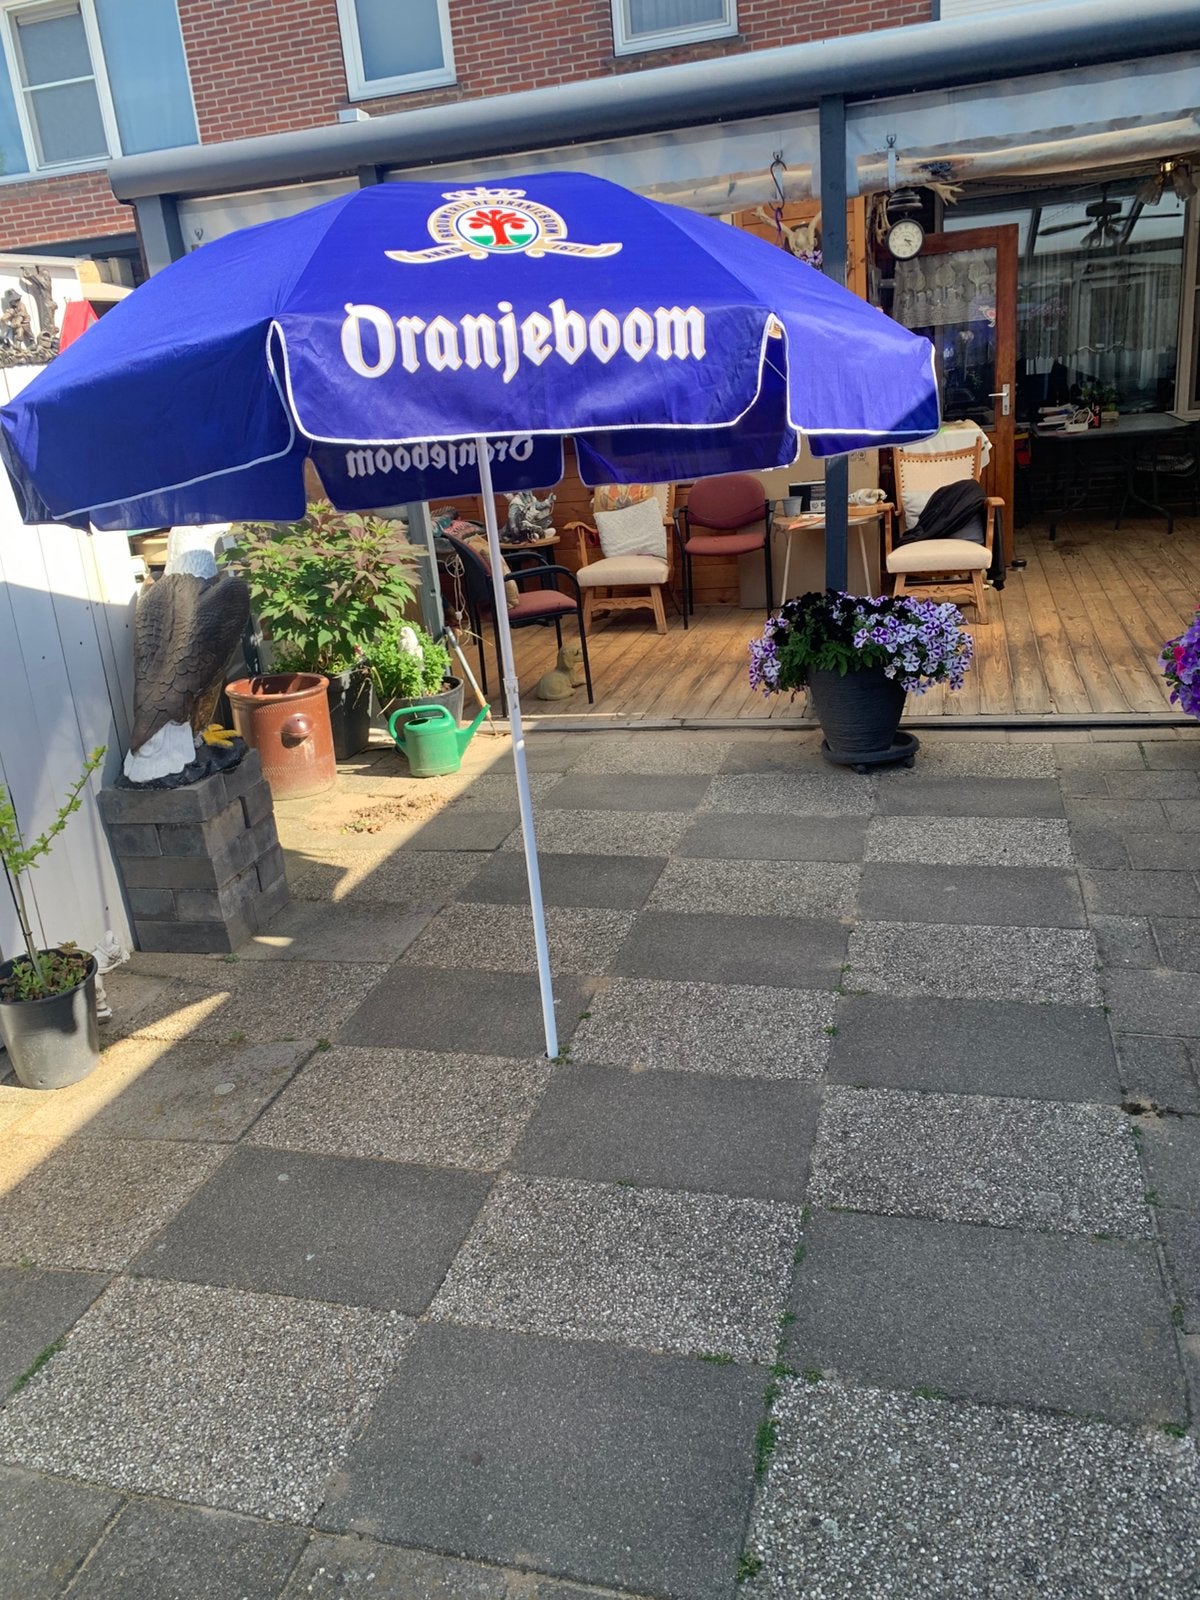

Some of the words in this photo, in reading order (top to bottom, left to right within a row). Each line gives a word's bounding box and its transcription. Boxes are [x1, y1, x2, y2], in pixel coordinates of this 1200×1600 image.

[436, 202, 469, 239] BROUWERIJ
[496, 199, 559, 234] ORANJEBOOM
[421, 247, 464, 259] ANNO
[341, 297, 706, 384] Oranjeboom
